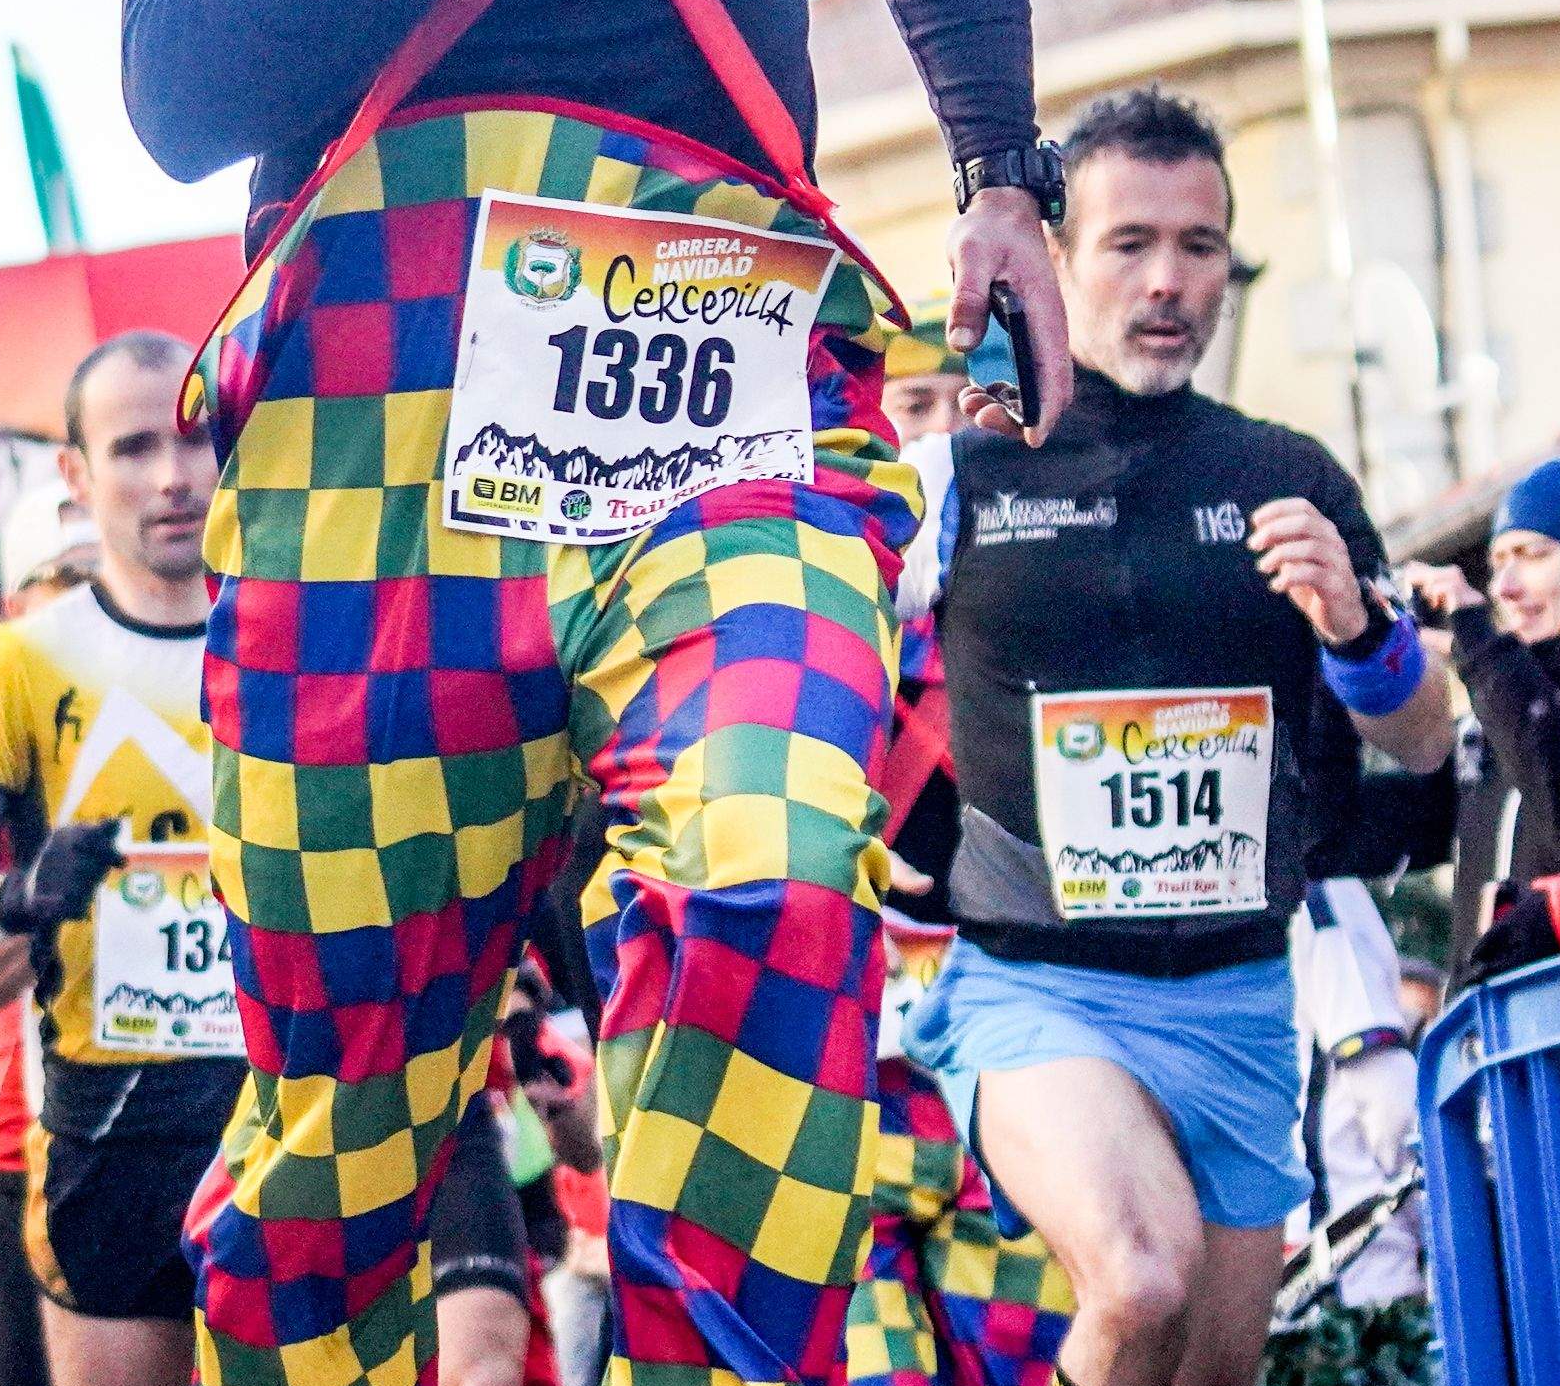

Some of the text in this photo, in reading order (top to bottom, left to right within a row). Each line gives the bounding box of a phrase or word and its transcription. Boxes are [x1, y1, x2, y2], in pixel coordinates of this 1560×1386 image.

[656, 238, 742, 259] CARRERA
[653, 256, 753, 284] NAVIDAD
[549, 324, 736, 428] 1336
[500, 482, 541, 505] BM
[607, 497, 666, 519] Trail
[1100, 768, 1223, 829] 1514
